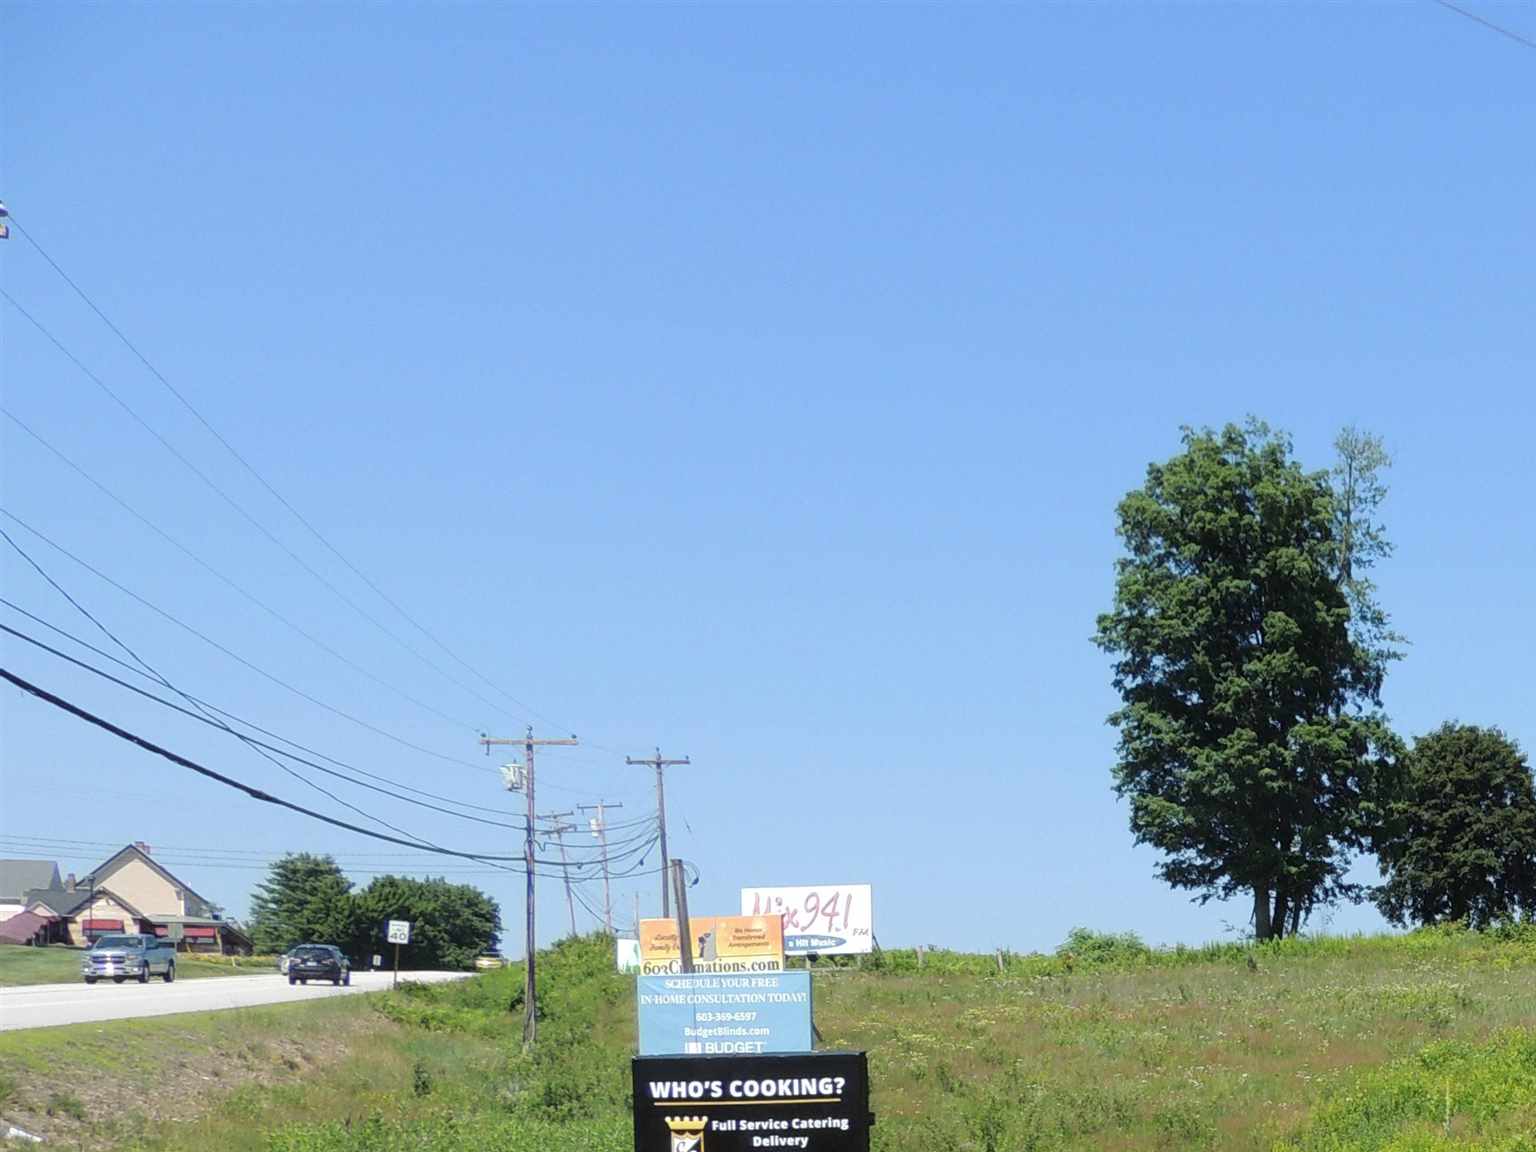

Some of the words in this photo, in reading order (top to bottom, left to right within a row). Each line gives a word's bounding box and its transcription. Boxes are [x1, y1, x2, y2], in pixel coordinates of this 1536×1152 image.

[390, 932, 406, 940] 40
[643, 959, 780, 976] 603Cmations.com
[665, 979, 719, 989] SCHEDULE
[721, 978, 749, 988] YOUR
[752, 977, 779, 988] FREE
[687, 993, 766, 1004] CONSULTATION
[684, 1026, 770, 1037] BudgetBlinds.com
[705, 1041, 764, 1053] BUDGET
[650, 1080, 723, 1098] WHO'S
[729, 1077, 845, 1097] COOKING?
[712, 1120, 736, 1131] Full
[739, 1119, 789, 1131] Service
[792, 1117, 849, 1130] Catering
[753, 1136, 808, 1149] Delivery
